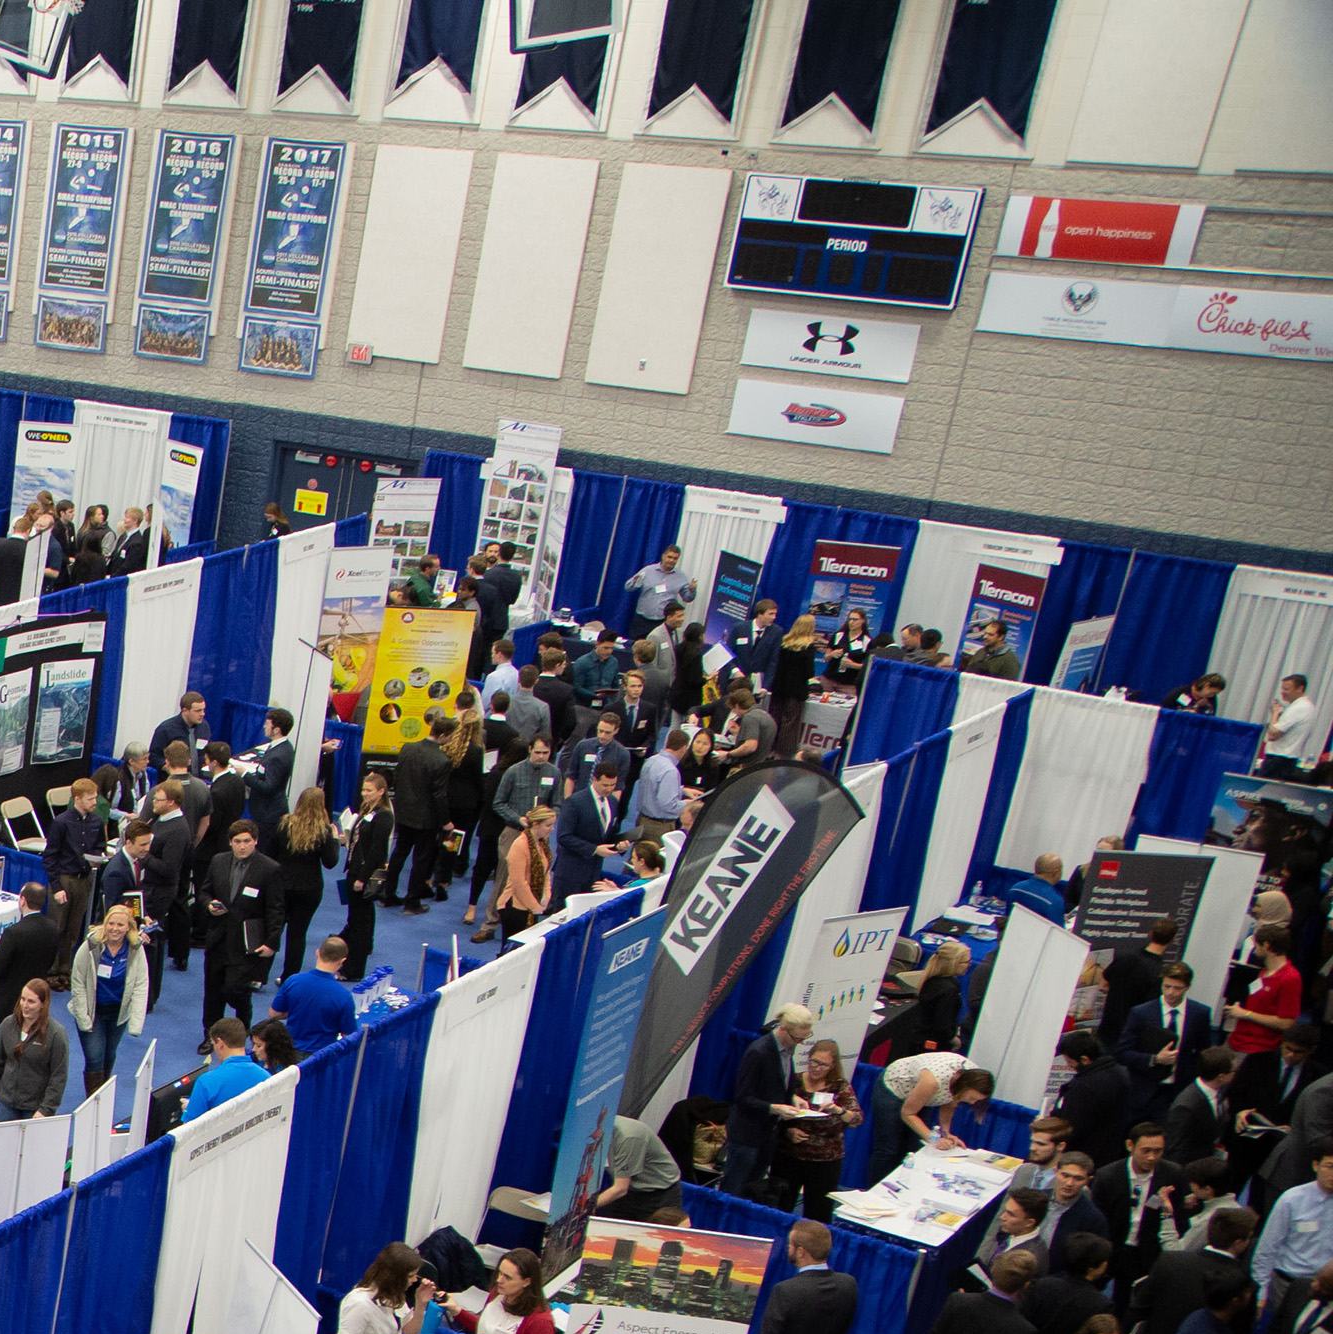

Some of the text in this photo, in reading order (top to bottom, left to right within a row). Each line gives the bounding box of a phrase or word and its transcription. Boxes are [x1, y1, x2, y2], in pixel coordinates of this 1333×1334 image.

[67, 132, 115, 149] 2015
[171, 140, 221, 155] 2016
[281, 148, 331, 164] 2017
[1065, 226, 1153, 240] open happiness
[827, 239, 867, 252] PERIOD
[49, 253, 106, 267] SEMI-FINALIST
[149, 262, 211, 277] SEMI-FINALIST
[255, 275, 319, 290] SEMI-FINALIST
[1197, 302, 1312, 341] Chick-fil-A
[790, 356, 861, 369] UNDER ARMOUR
[819, 557, 888, 579] Terracon
[980, 580, 1034, 607] Terracon
[46, 670, 86, 689] Landslide
[669, 815, 781, 953] KEANE
[849, 928, 894, 956] IPT
[613, 942, 646, 968] KEANE
